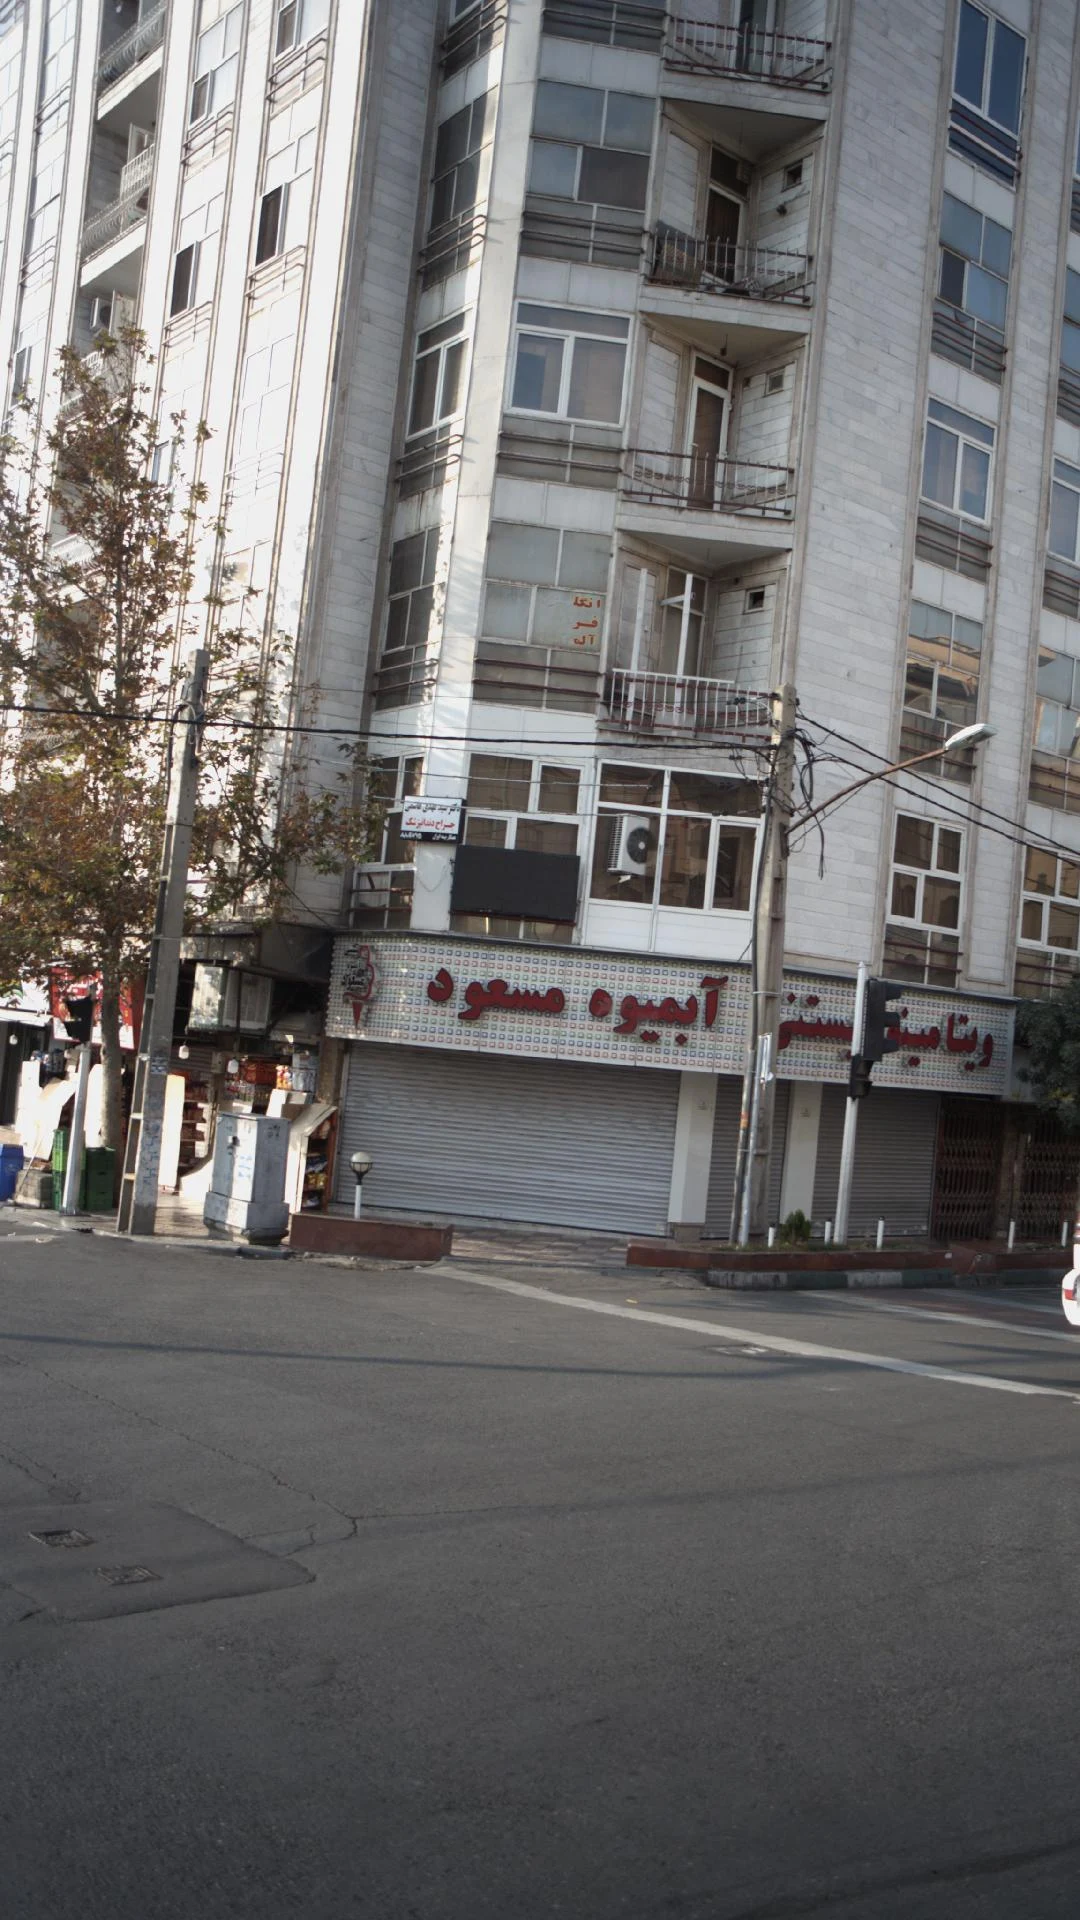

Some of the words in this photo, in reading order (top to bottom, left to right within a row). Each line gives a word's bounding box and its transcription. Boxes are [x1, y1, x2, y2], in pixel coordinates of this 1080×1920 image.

[435, 819, 455, 831] جراح
[426, 967, 566, 1021] مسعود
[589, 975, 729, 1047] آبمیوه
